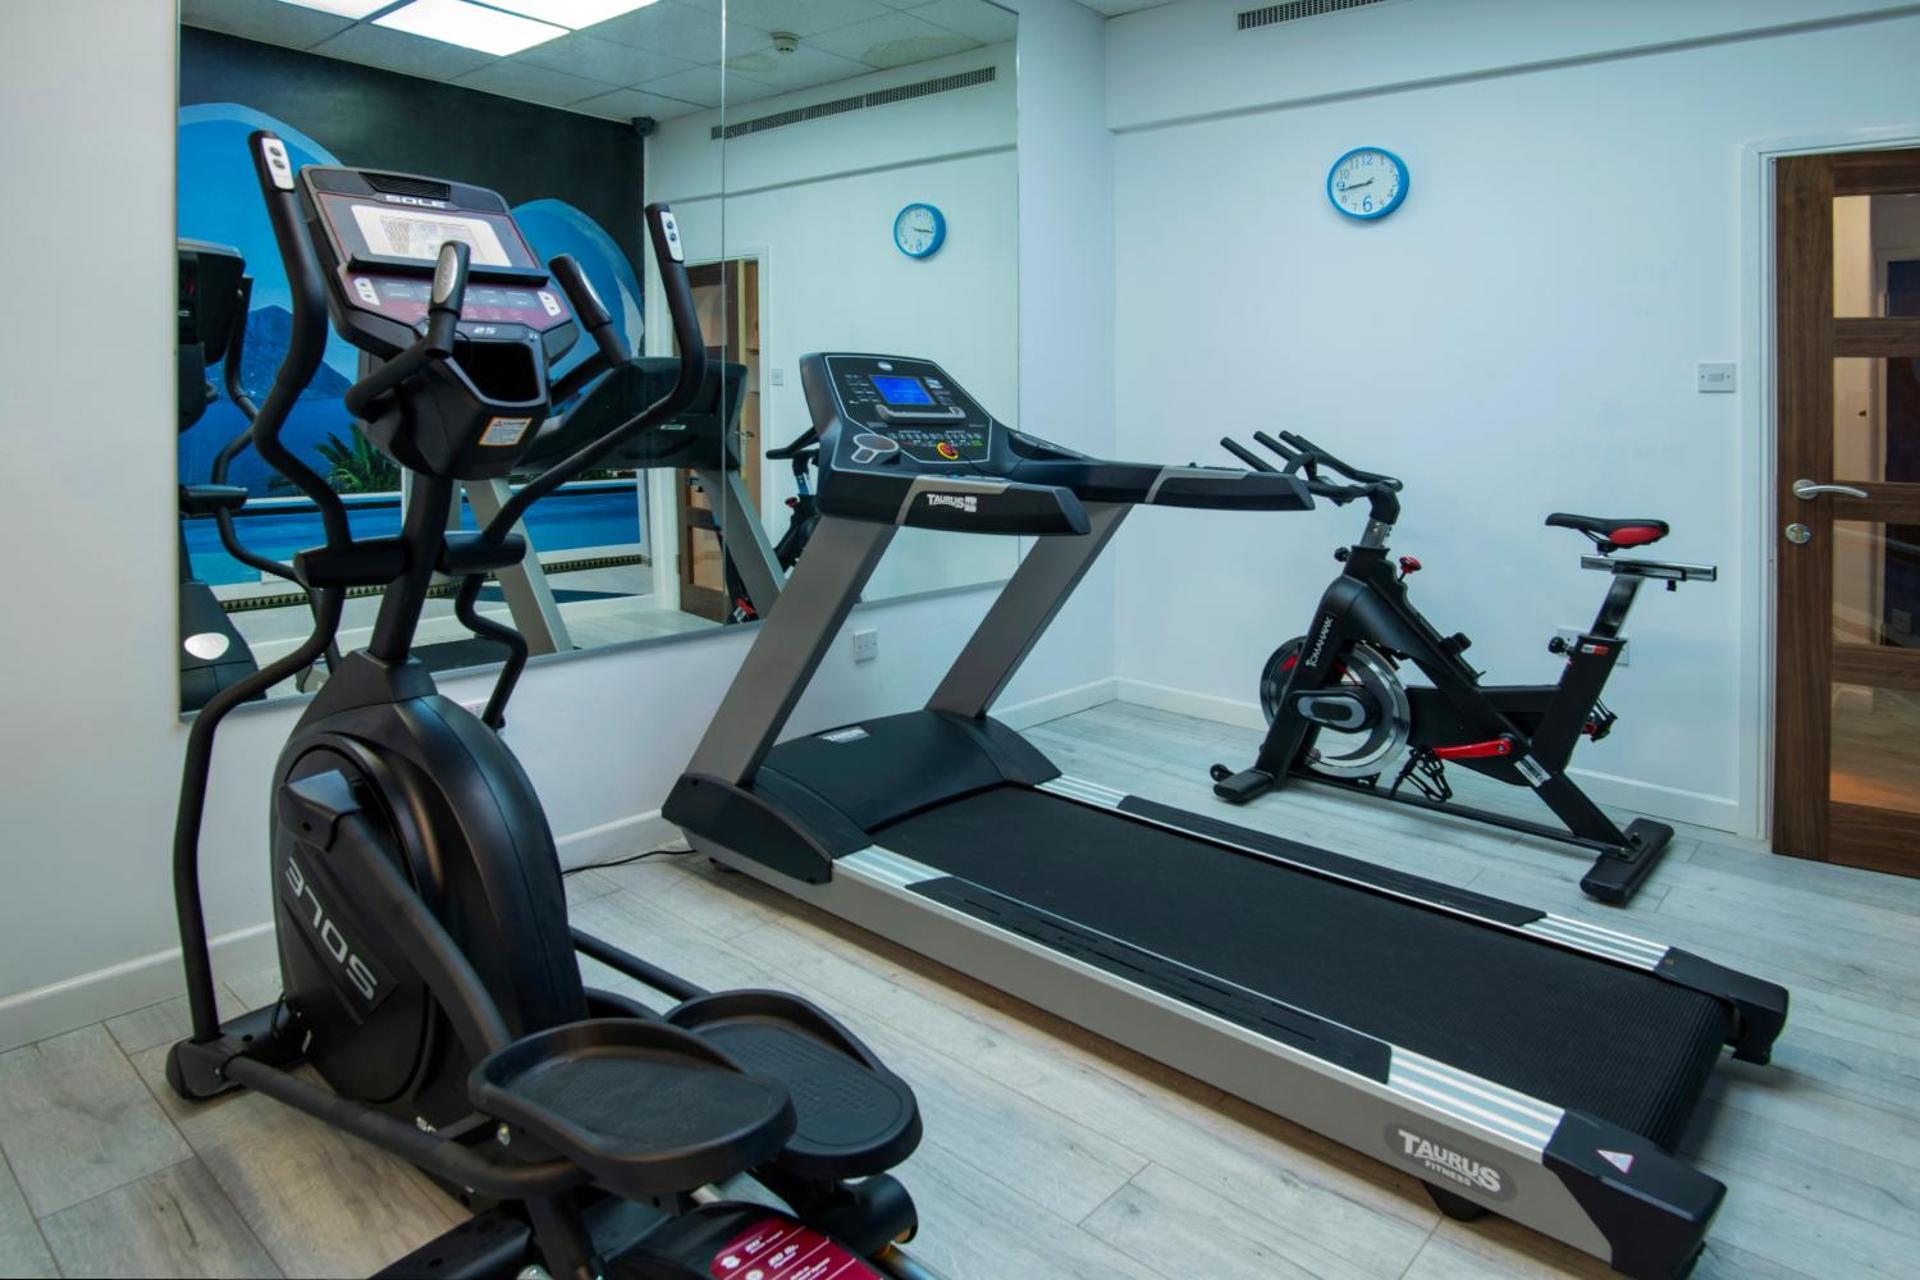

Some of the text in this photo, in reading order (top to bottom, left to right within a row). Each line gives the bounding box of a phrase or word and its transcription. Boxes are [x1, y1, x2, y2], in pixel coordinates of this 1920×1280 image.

[1362, 154, 1373, 166] 12
[385, 195, 446, 209] SOLE
[1362, 196, 1373, 212] 6
[926, 493, 965, 510] TAURUS
[285, 857, 378, 1001] SOLE
[1397, 1128, 1501, 1192] TAURUS
[1424, 1160, 1472, 1187] FITNESS
